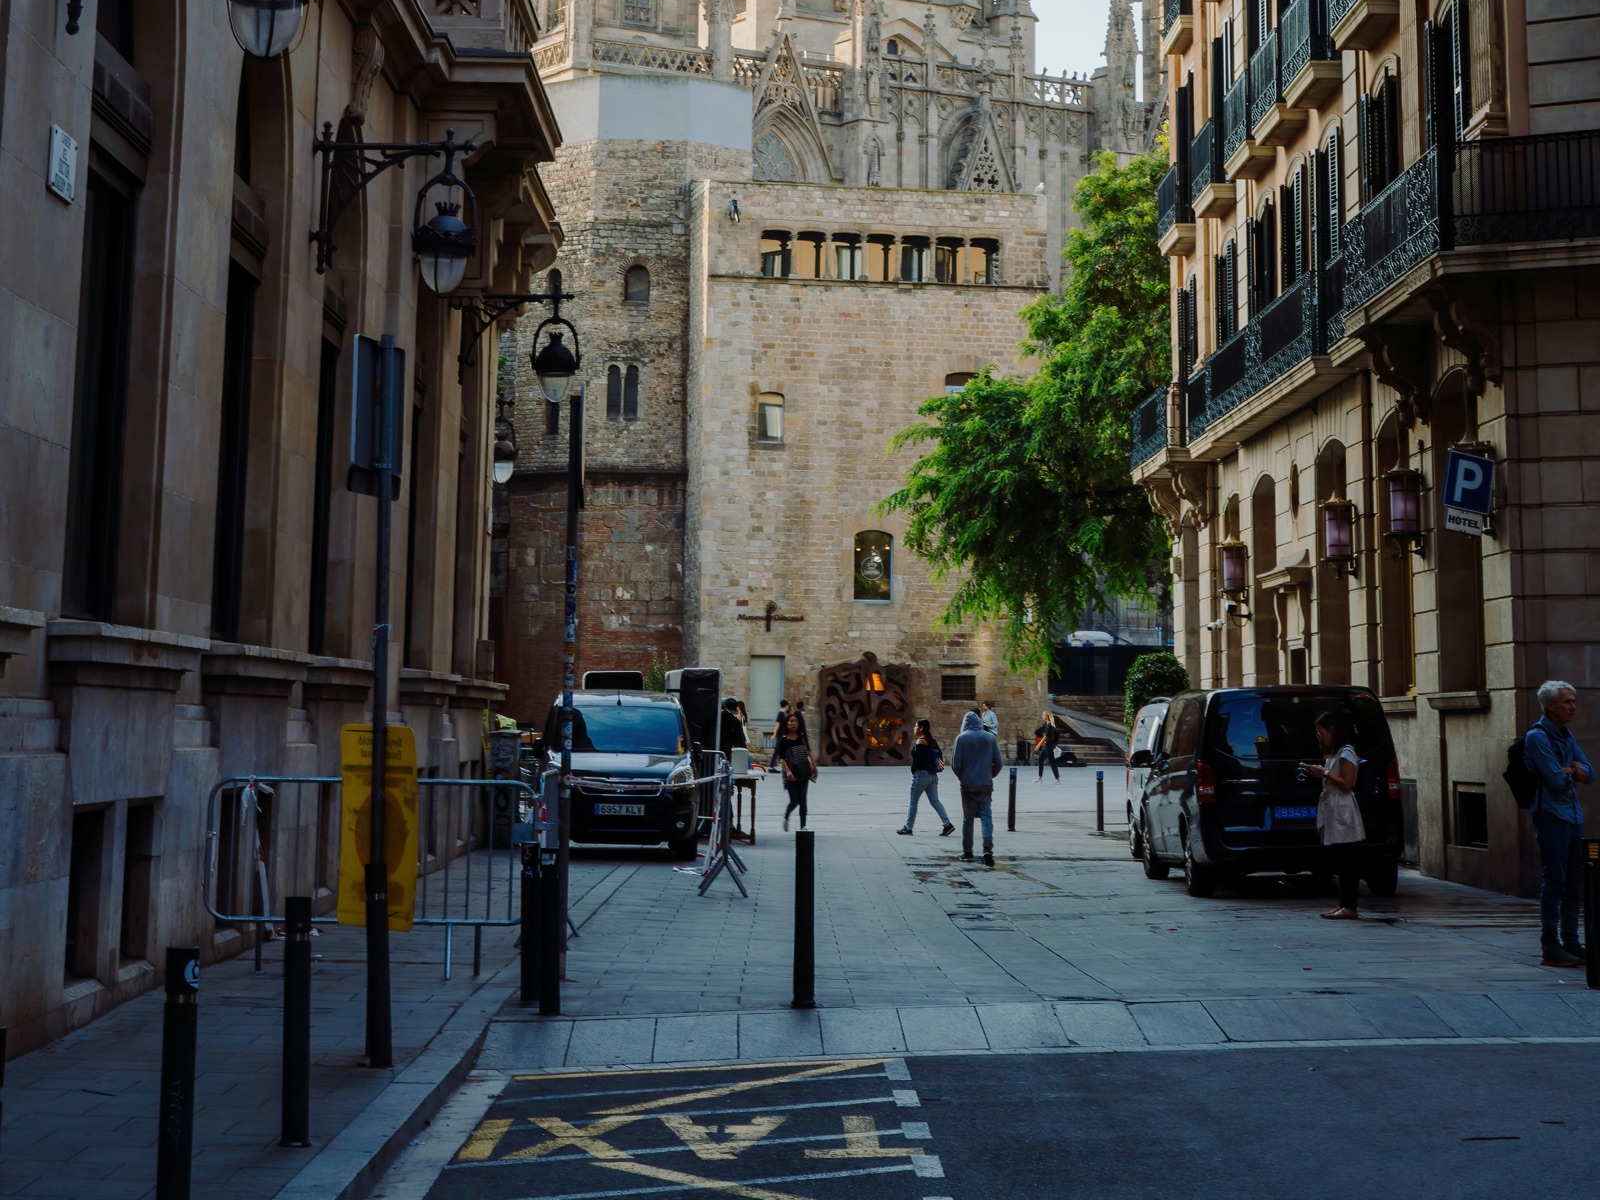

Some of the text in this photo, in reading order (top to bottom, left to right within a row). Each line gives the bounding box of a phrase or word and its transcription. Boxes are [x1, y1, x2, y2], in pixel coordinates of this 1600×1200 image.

[1453, 459, 1483, 503] P
[1448, 514, 1480, 530] HOTEL
[601, 804, 623, 814] 6957
[457, 1115, 925, 1161] TAXI
